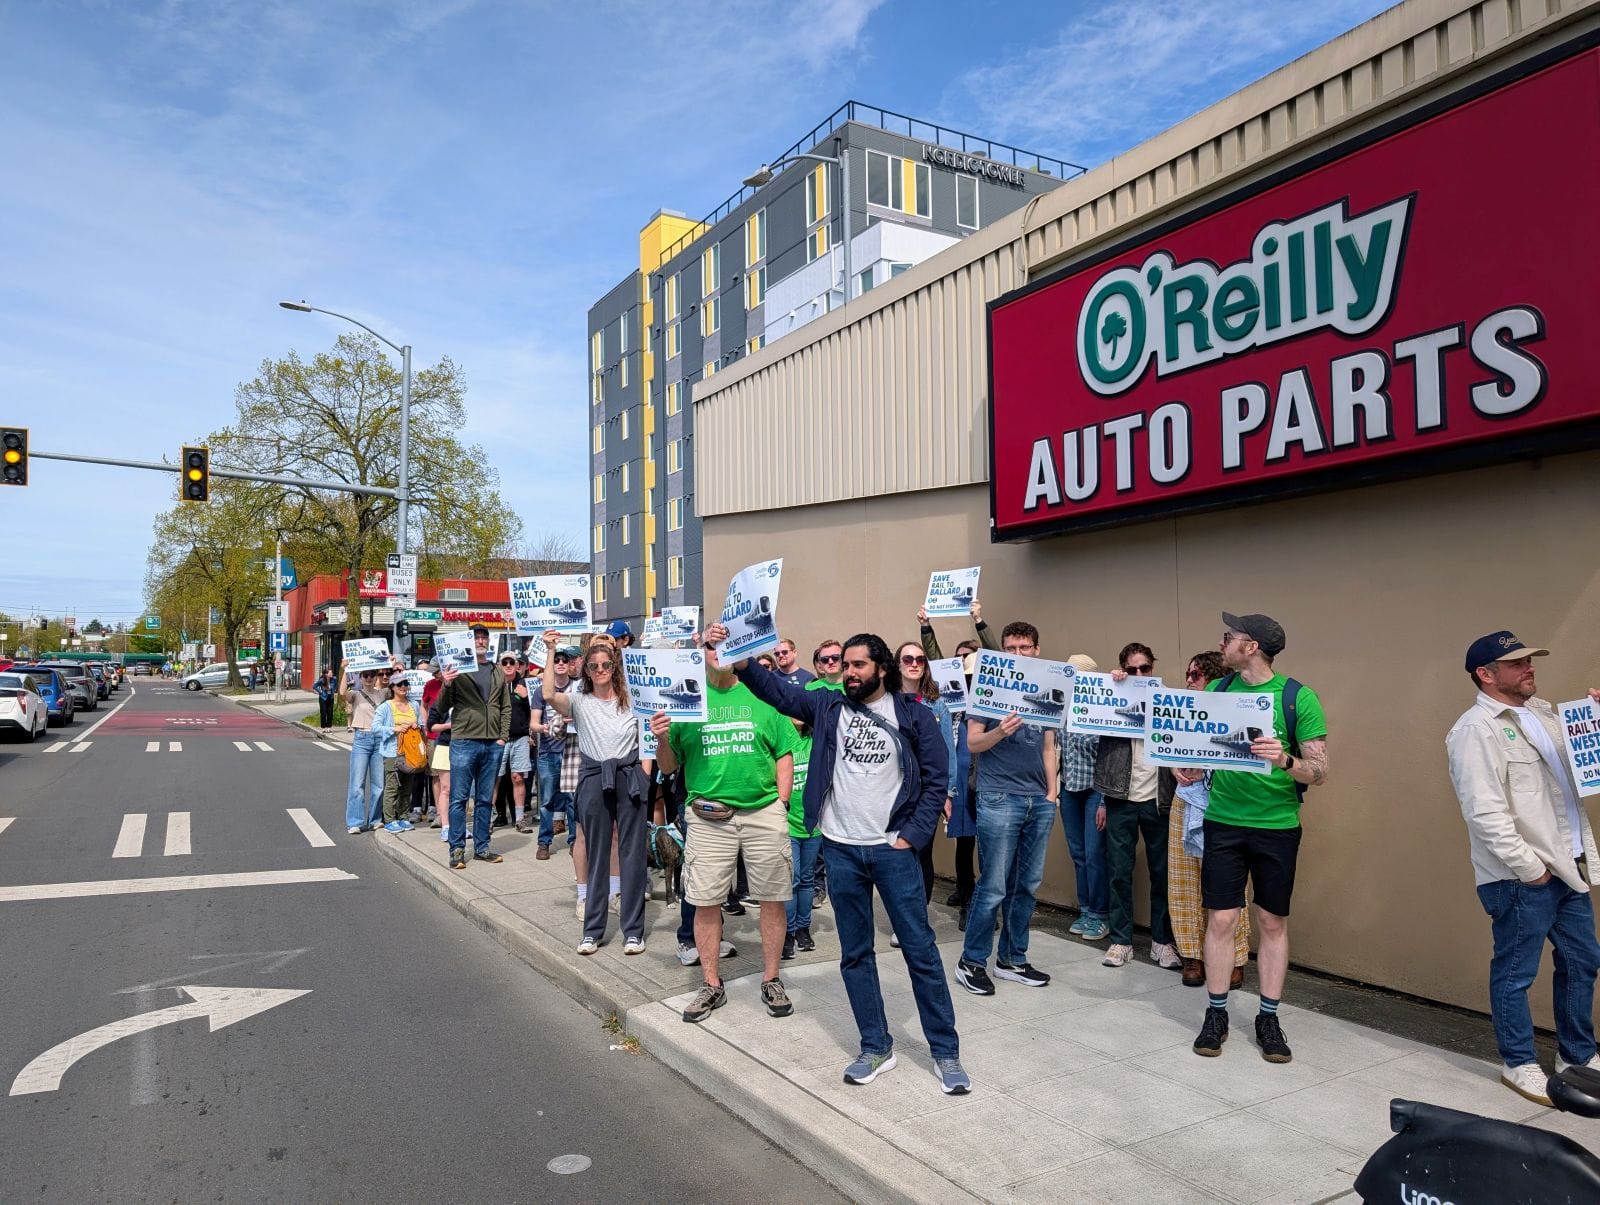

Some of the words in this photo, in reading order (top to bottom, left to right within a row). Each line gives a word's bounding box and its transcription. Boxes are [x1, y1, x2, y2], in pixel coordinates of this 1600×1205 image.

[922, 144, 980, 172] NORDIC
[980, 160, 1025, 186] TOWER
[1080, 212, 1398, 390] O'Reilly
[1023, 402, 1192, 511] AUTO
[1220, 305, 1547, 470] PARTS
[932, 574, 951, 582] SAVE
[512, 581, 537, 591] SAVE
[930, 586, 961, 596] BALLARD
[513, 591, 532, 600] RAIL
[534, 590, 546, 599] TO
[733, 591, 742, 606] TO
[514, 597, 561, 609] BALLARD
[721, 599, 752, 624] ALLARD
[272, 633, 285, 648] H
[742, 632, 753, 643] STOP
[625, 654, 647, 665] SAVE
[981, 654, 1015, 669] SAVE
[626, 665, 642, 675] RAIL
[645, 666, 656, 676] TO
[979, 665, 1005, 678] RAIL
[1009, 671, 1025, 681] TO
[628, 676, 672, 687] BALLARD
[977, 674, 1039, 694] BALLARD
[1074, 675, 1104, 687] SAVE
[1073, 685, 1097, 695] RAIL
[1099, 688, 1113, 697] TO
[652, 702, 668, 710] STOP
[978, 698, 990, 706] DO
[992, 701, 1008, 710] NOT
[1010, 704, 1030, 714] STOP
[1073, 694, 1128, 707] BALLARD
[1152, 693, 1195, 709] SAVE
[1152, 706, 1185, 719] RAIL
[1189, 710, 1209, 721] TO
[1564, 705, 1594, 724] SAVE
[1104, 719, 1123, 727] STOP
[1151, 718, 1229, 735] BALLARD
[1567, 721, 1591, 738] RAIL
[701, 731, 755, 745] BALLARD
[856, 728, 879, 741] the
[843, 736, 887, 750] Damn
[1569, 732, 1600, 752] WEST
[703, 745, 731, 756] LIGHT
[732, 744, 755, 753] RAIL
[842, 749, 891, 764] Trains!
[1157, 746, 1171, 754] DO
[1174, 748, 1194, 756] NOT
[1196, 750, 1221, 758] STOP
[1583, 770, 1594, 779] DO
[1401, 1183, 1456, 1205] Lim
